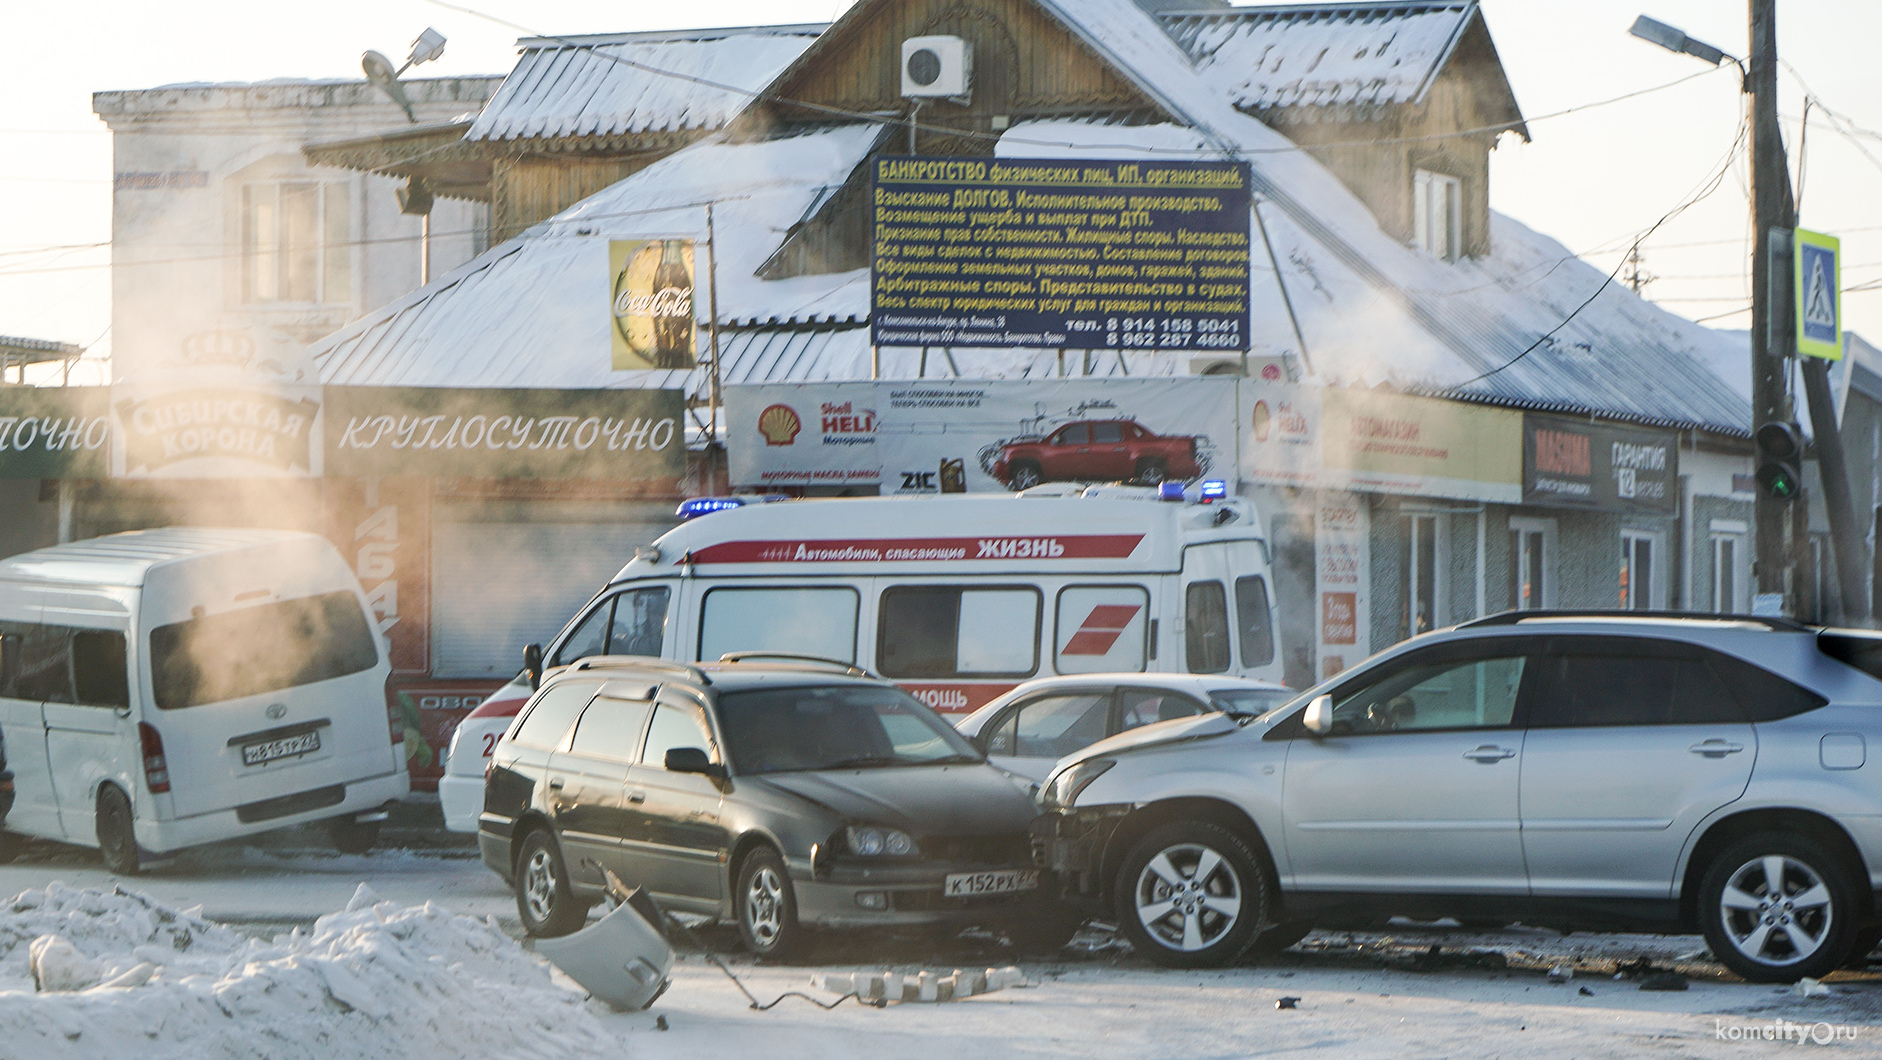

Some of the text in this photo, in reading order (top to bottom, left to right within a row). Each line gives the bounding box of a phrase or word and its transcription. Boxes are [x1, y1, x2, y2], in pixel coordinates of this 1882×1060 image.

[878, 160, 986, 181] БАНКРОТСТВО
[989, 162, 1080, 184] физических
[1083, 168, 1114, 186] лиц,
[1146, 165, 1243, 188] организаций.
[875, 187, 1223, 214] Взыскание ДОЛГОВ. Исполнительное производство.
[876, 206, 1153, 229] Возмещение ущерба и выплат при ДТП.
[876, 224, 1248, 248] Признание прав собственности. Жилищные споры. Наследство.
[876, 241, 899, 257] Все
[902, 245, 935, 259] виды
[937, 245, 983, 259] сделок
[985, 246, 993, 258] с
[996, 246, 1100, 261] недвижимостью.
[1102, 244, 1183, 262] Составление
[876, 258, 958, 277] Оформление
[961, 262, 1032, 276] земельных
[1034, 263, 1093, 280] участков,
[1095, 264, 1138, 280] домов,
[1140, 262, 1196, 281] гаражей,
[876, 275, 1247, 300] Арбитражные споры. Представительство в судах.
[877, 293, 1247, 315] Весь спектр юридических услуг для граждан и организаций.
[1106, 317, 1119, 332] 8
[1122, 317, 1155, 333] 914
[1160, 318, 1193, 333] 158
[1197, 319, 1239, 334] 5041
[1106, 332, 1241, 348] 8 962 287 4660
[821, 401, 851, 415] Shell
[338, 415, 676, 451] КРУГЛОСУТОЧНО
[1612, 441, 1666, 470] ГАРАНТИЯ
[900, 471, 937, 489] ZIC
[794, 538, 1065, 562] Автомобили, спасающие ЖИЗНЬ
